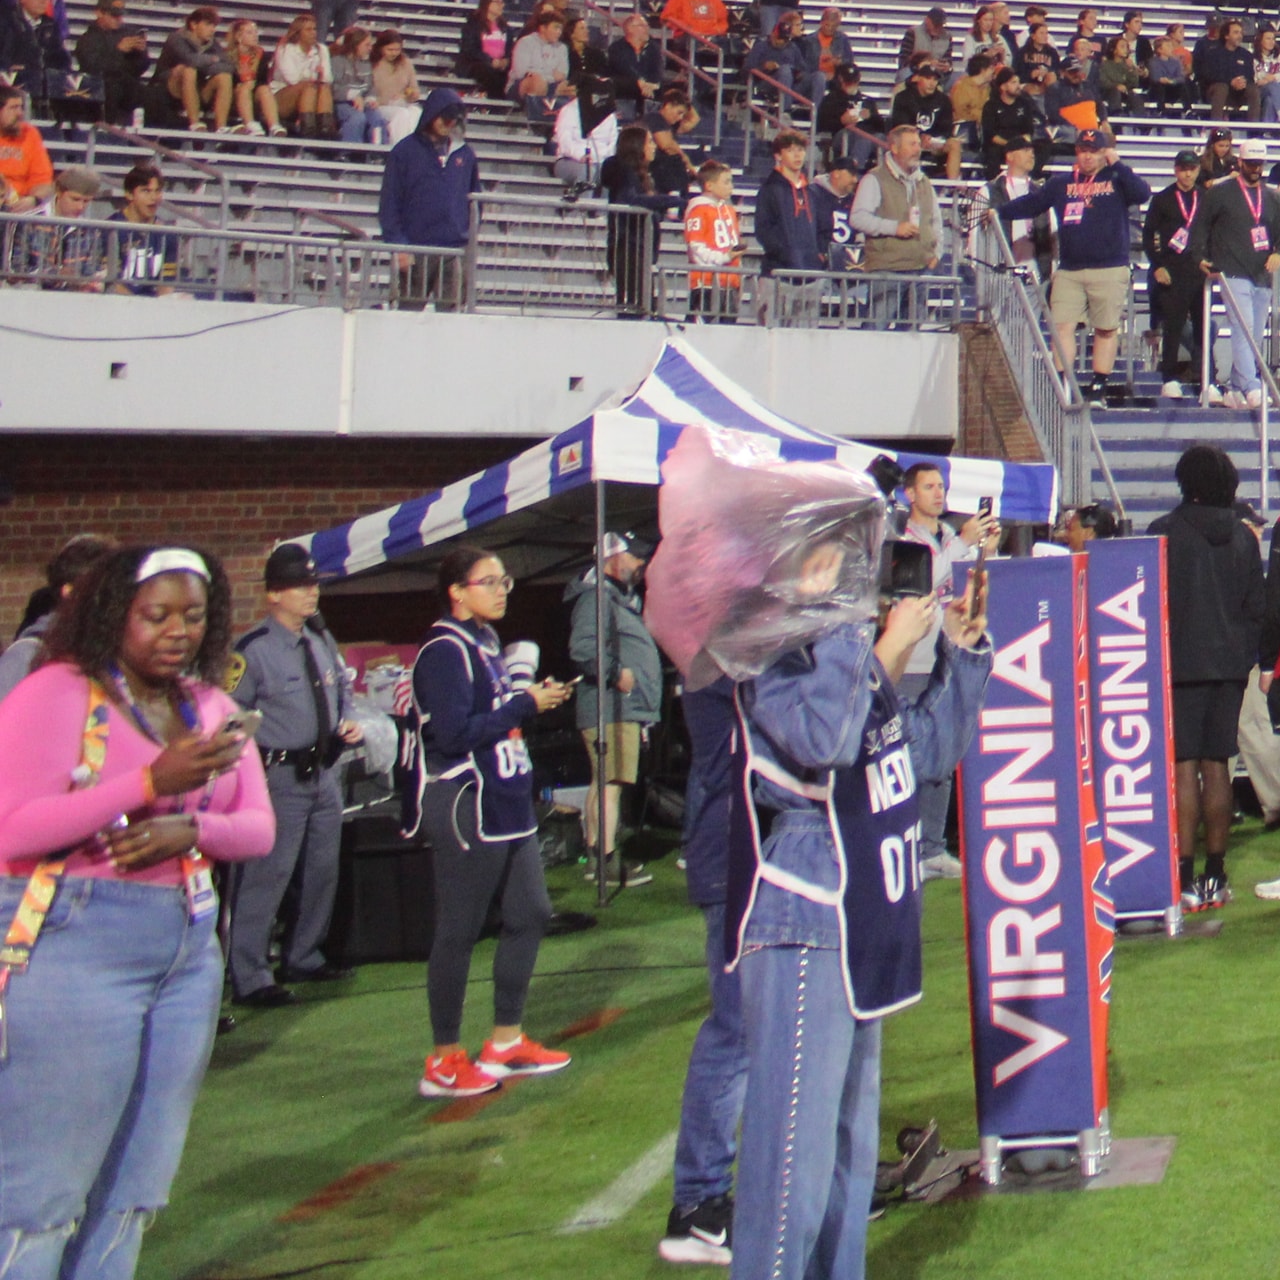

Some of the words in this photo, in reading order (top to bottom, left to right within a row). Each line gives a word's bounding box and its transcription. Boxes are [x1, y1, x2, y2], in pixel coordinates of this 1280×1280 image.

[832, 211, 851, 244] 5
[980, 622, 1069, 1088] VIRGINIA
[1097, 579, 1156, 878] VIRGINIA
